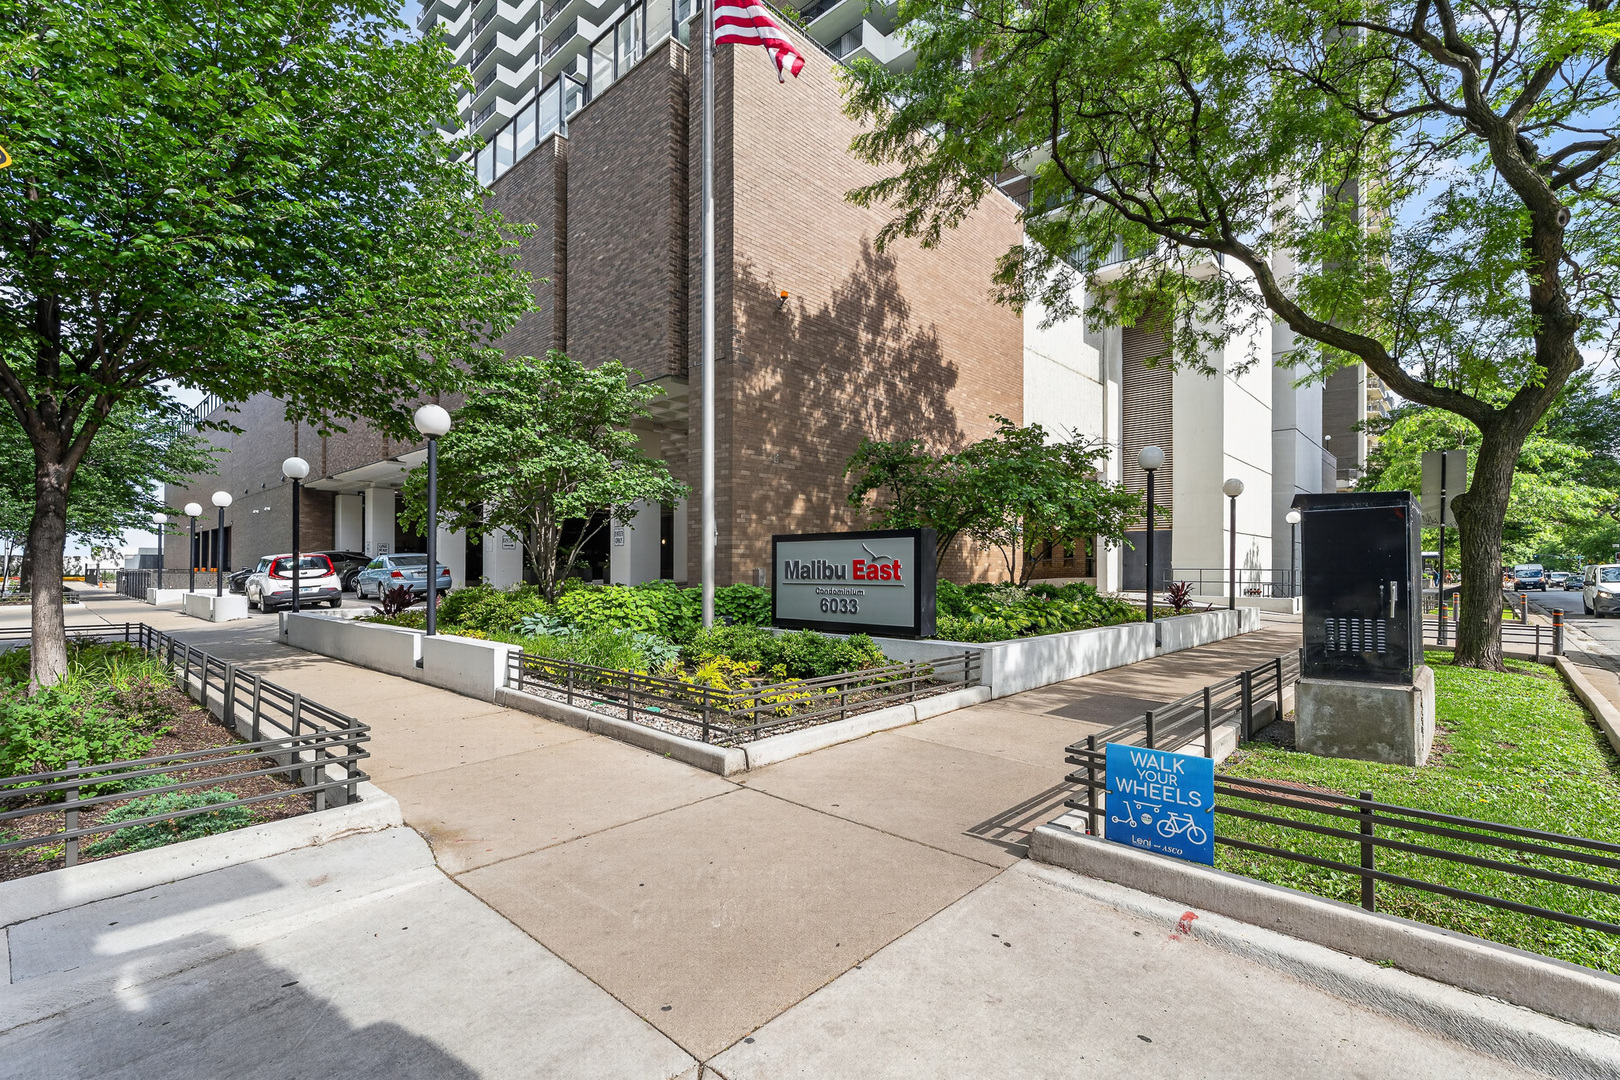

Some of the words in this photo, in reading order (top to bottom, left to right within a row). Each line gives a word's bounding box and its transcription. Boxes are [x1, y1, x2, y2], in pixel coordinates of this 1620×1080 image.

[784, 559, 847, 580] Malibu
[852, 559, 902, 581] East
[815, 587, 865, 596] Condominium
[819, 597, 860, 614] 6033
[1130, 750, 1185, 775] WALK
[1136, 768, 1178, 786] YOUR
[1115, 776, 1202, 807] WHEELS
[1131, 834, 1152, 847] Leni
[1162, 845, 1183, 855] ASCO
